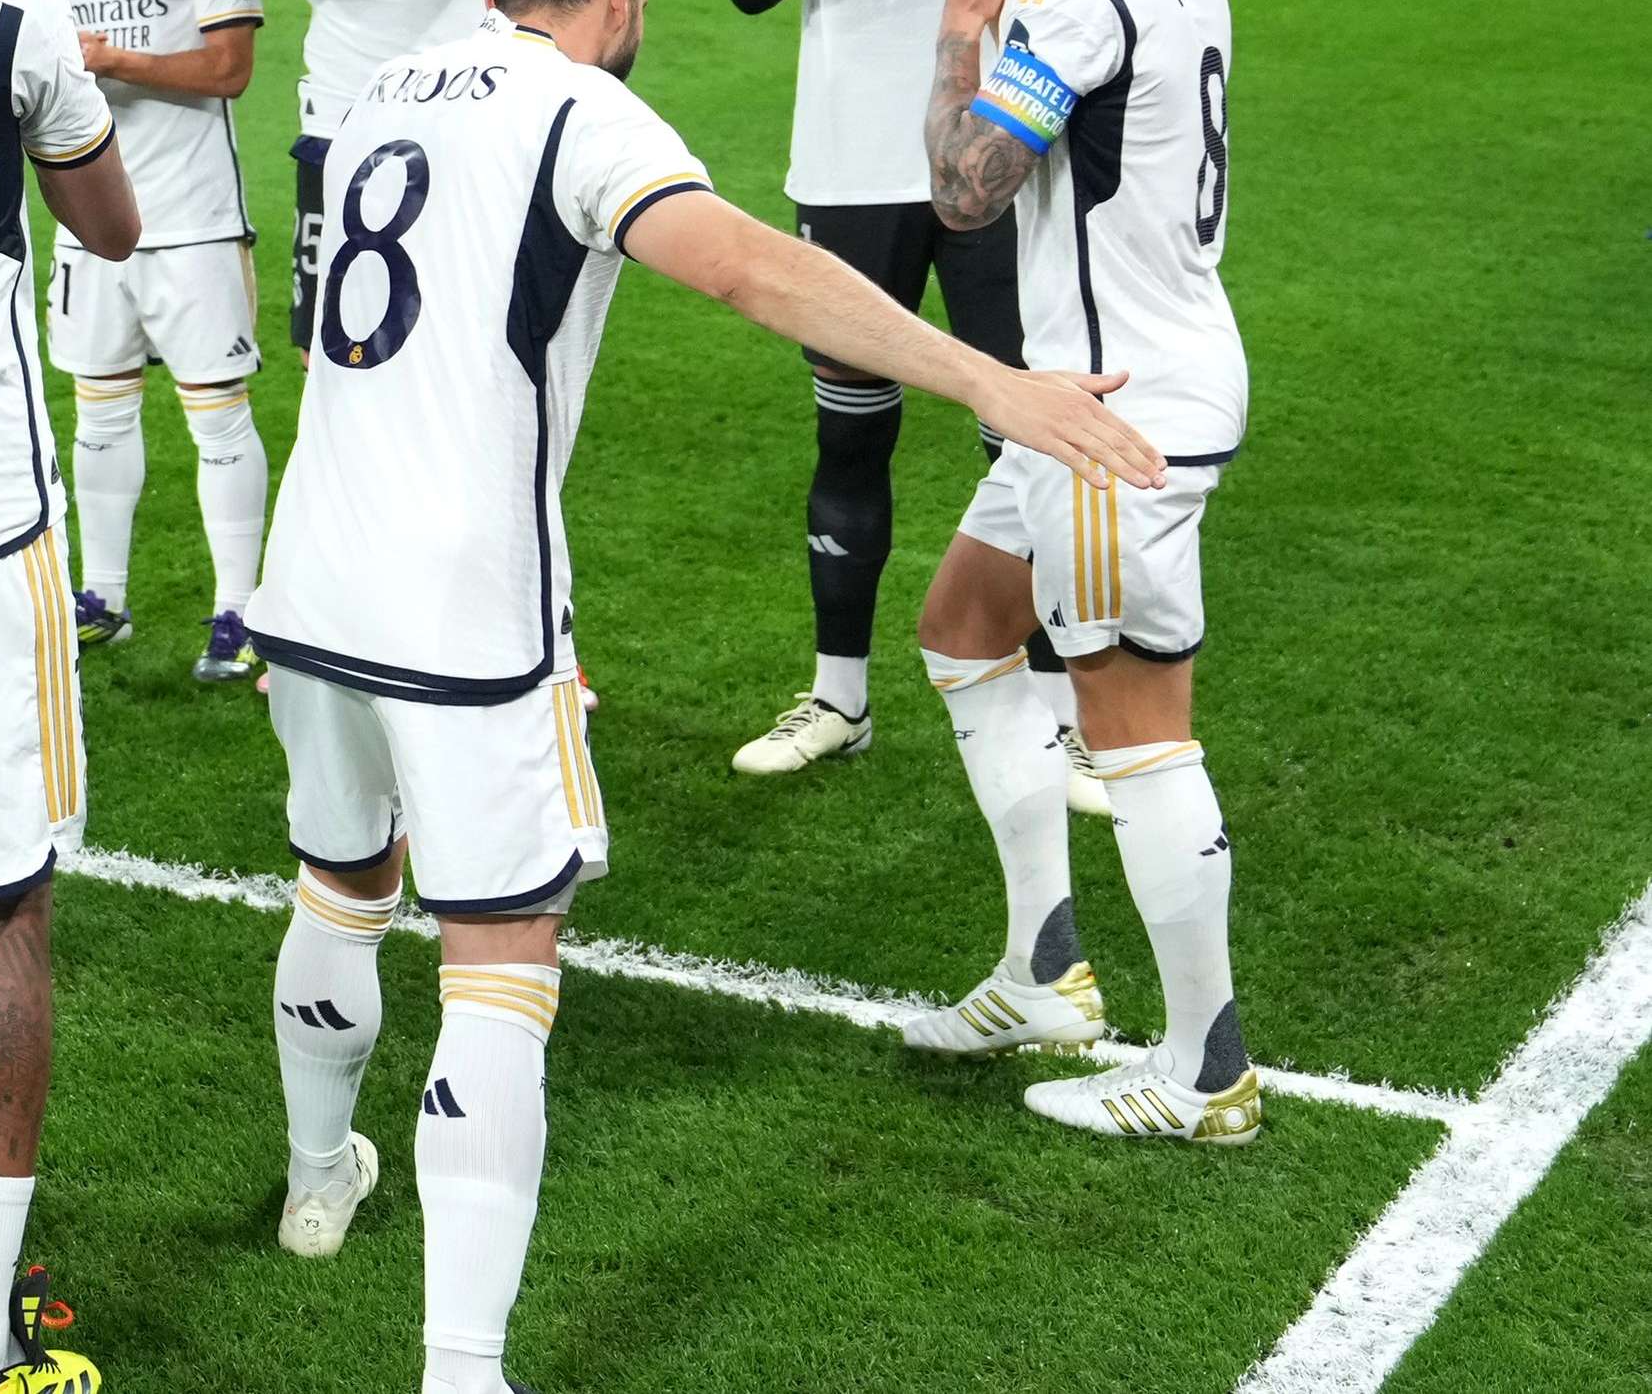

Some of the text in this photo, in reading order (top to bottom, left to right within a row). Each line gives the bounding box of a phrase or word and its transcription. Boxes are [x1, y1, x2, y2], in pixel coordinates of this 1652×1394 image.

[367, 64, 508, 104] KROOS
[983, 76, 1067, 137] ALNUTRICIÓ
[996, 56, 1065, 106] COMBATE
[1195, 45, 1228, 247] 8
[293, 208, 324, 276] 5
[321, 138, 431, 370] 8
[48, 257, 71, 316] 1
